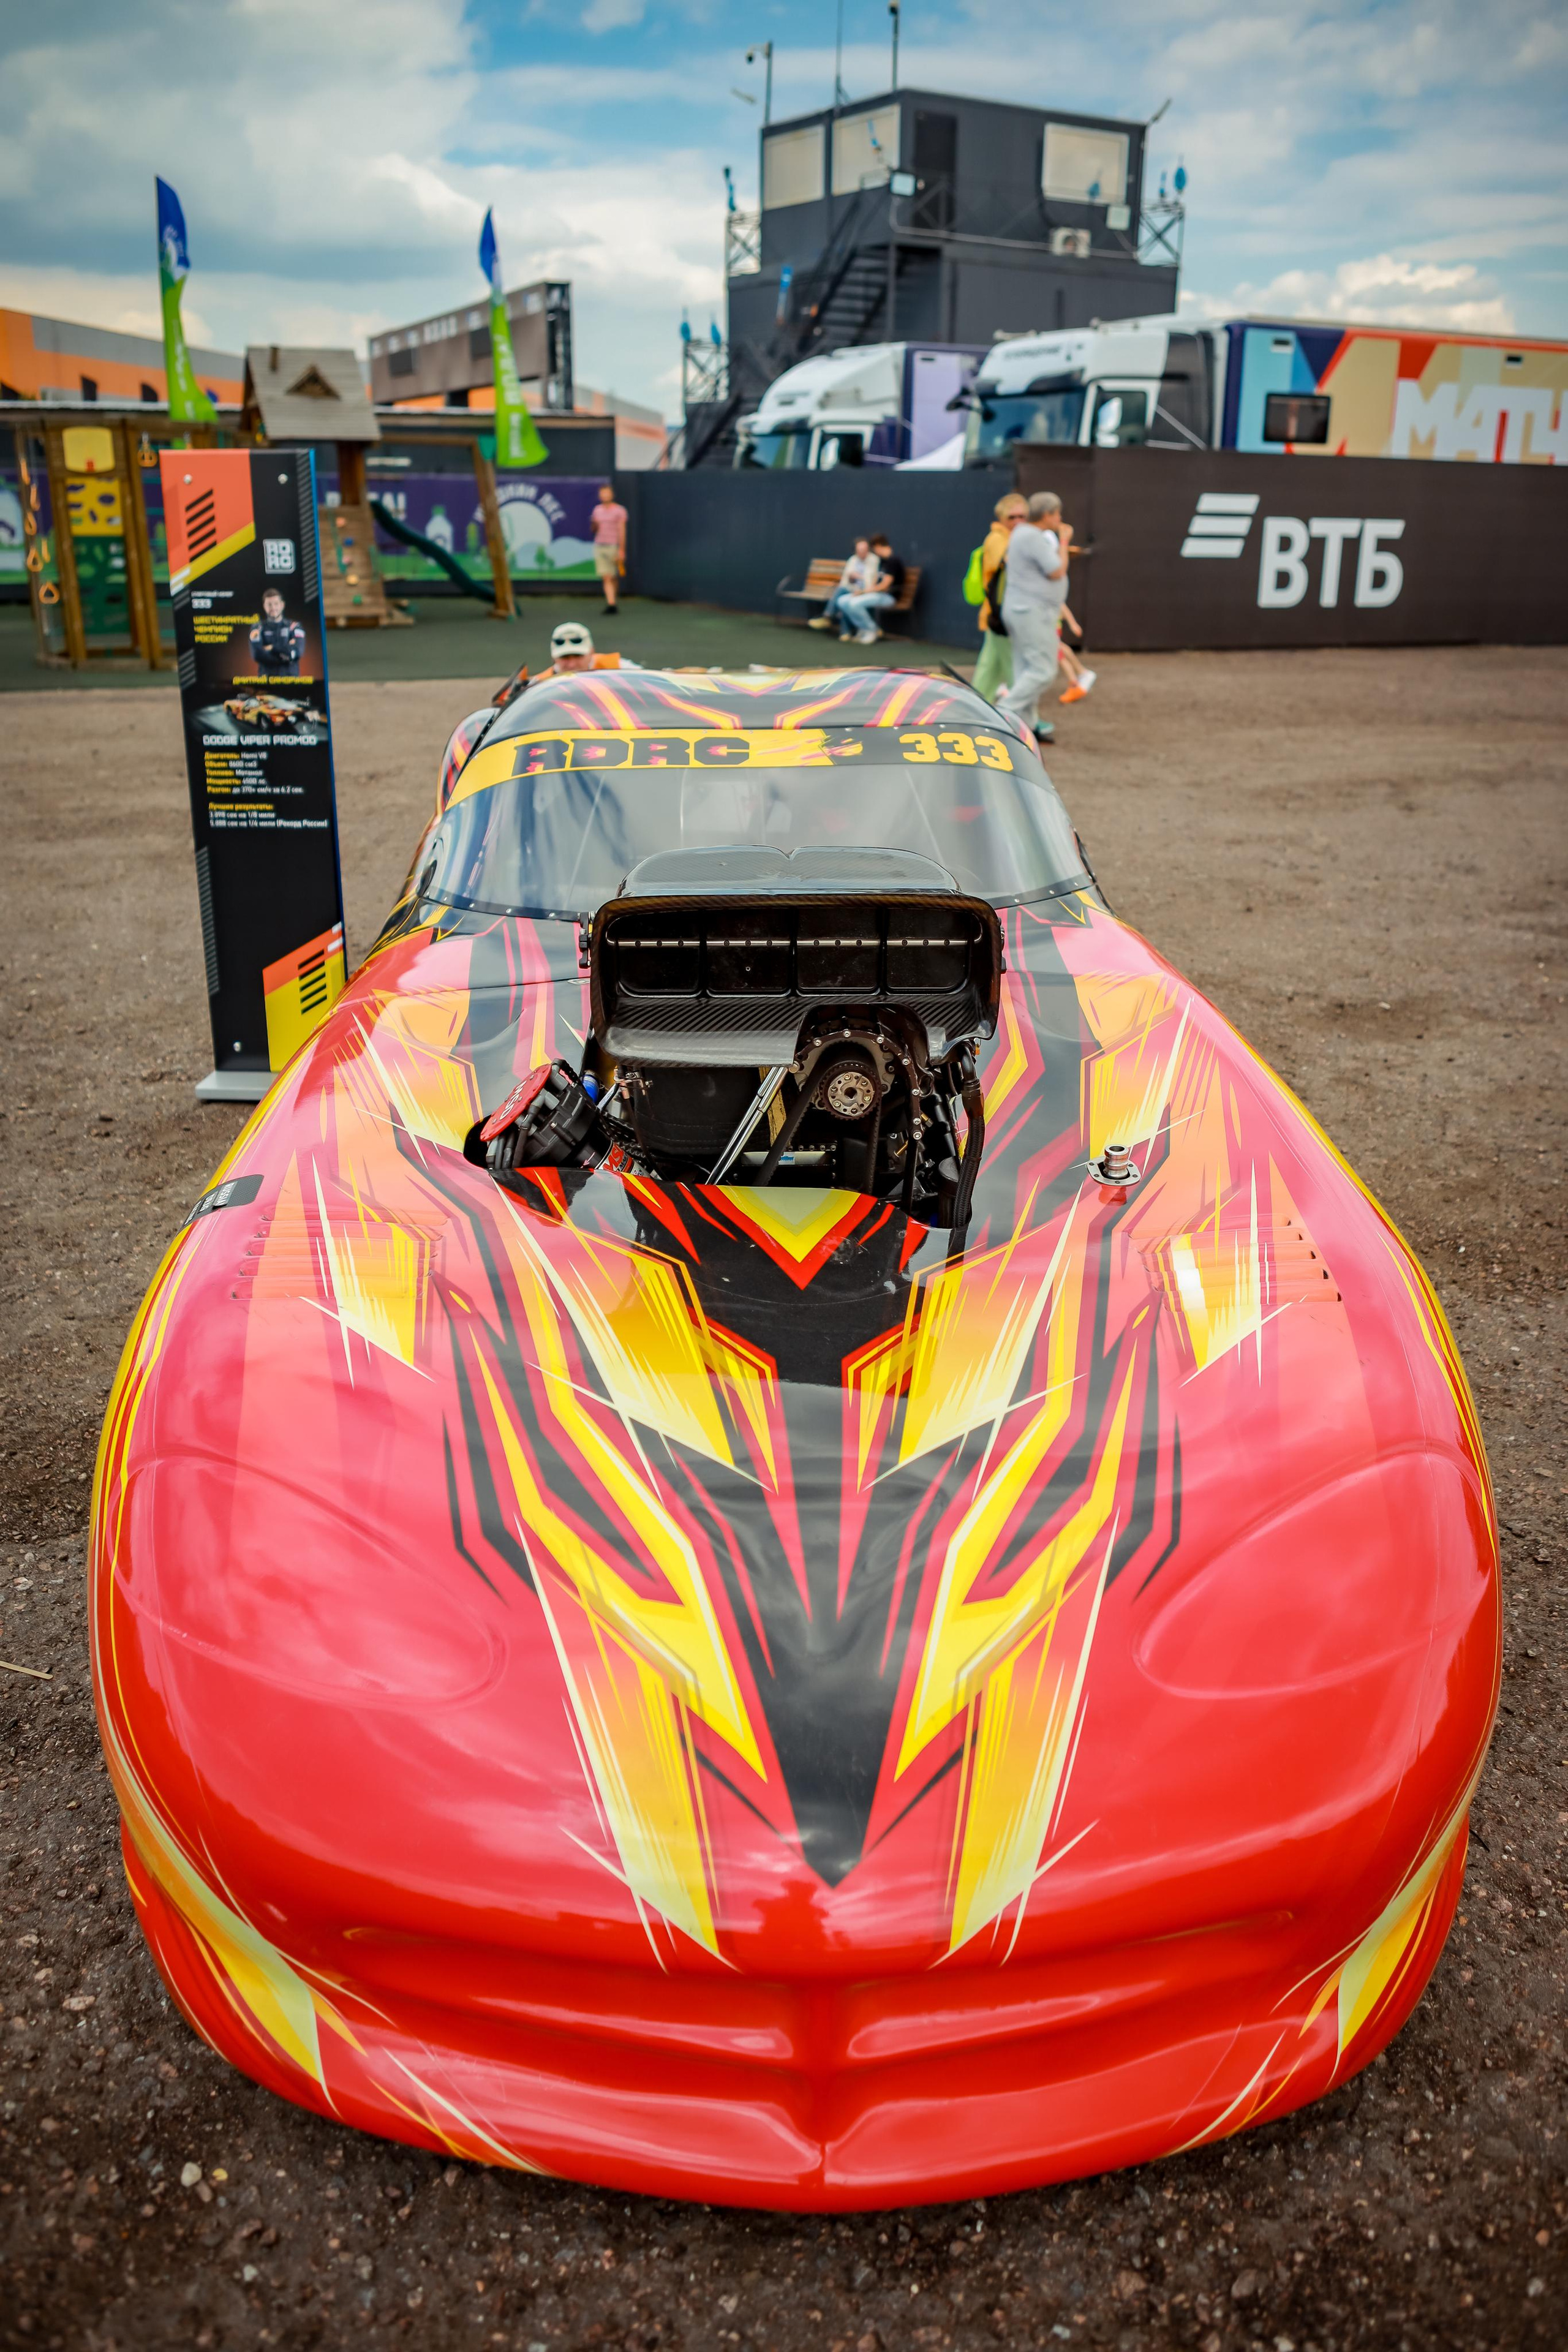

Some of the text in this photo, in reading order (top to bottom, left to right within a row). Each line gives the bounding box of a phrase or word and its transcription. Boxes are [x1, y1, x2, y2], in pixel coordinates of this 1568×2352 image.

[1257, 516, 1406, 608] ВТБ
[203, 735, 238, 745] DODGE
[240, 735, 271, 745] VIPER
[511, 733, 1013, 777] RDRC 333
[499, 1080, 527, 1121] MSD
